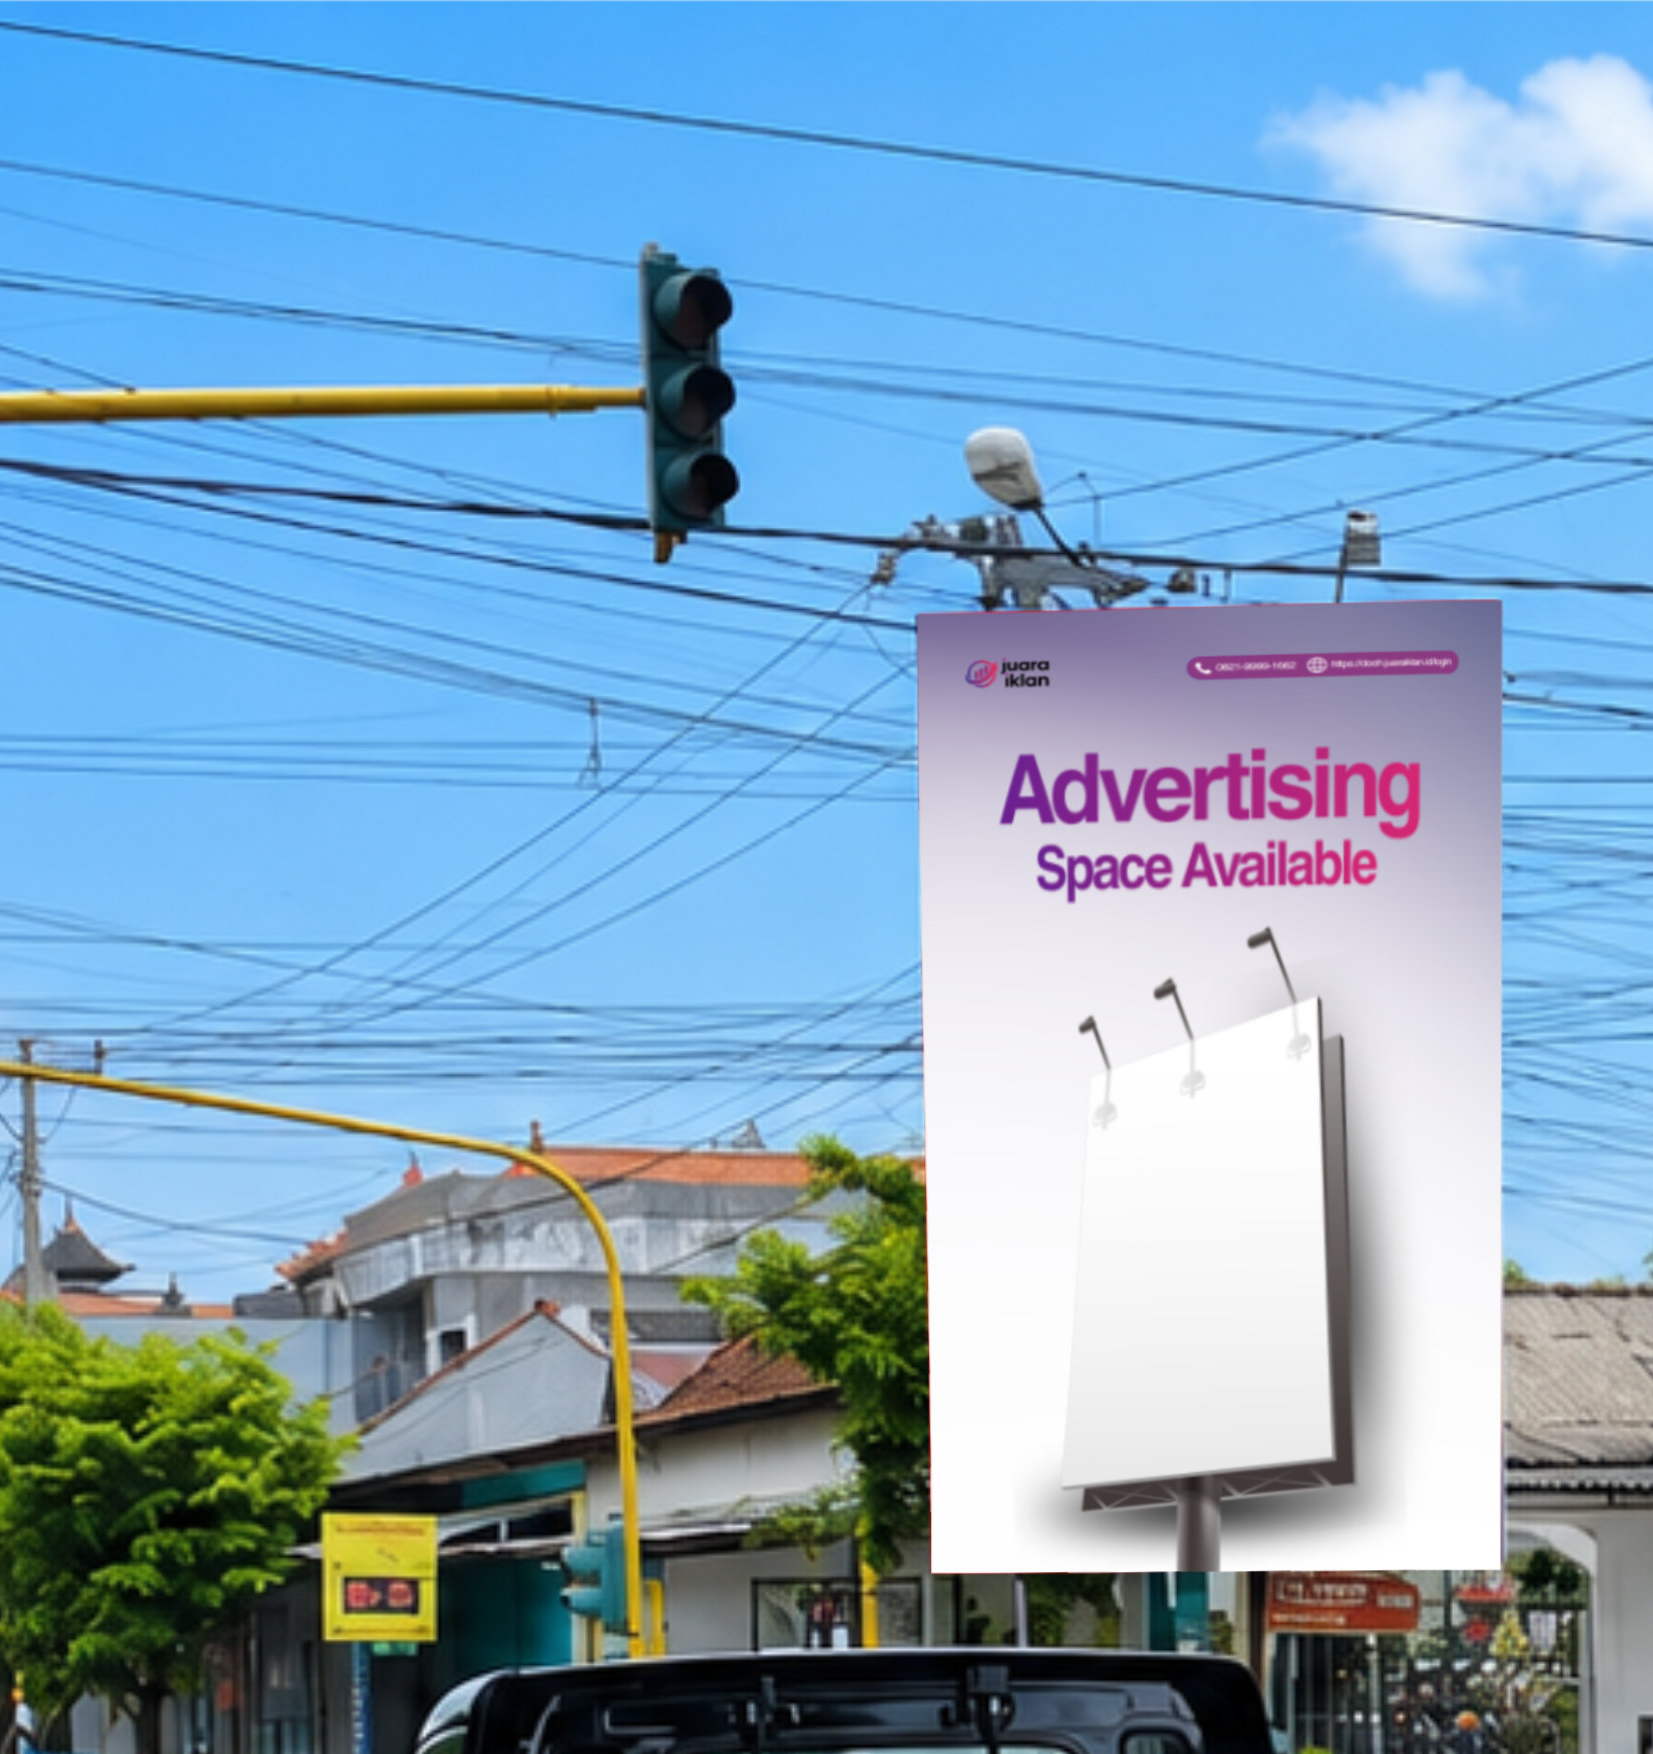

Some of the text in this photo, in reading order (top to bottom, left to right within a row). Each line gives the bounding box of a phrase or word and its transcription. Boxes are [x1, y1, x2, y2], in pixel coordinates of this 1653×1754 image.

[1000, 657, 1050, 674] juara
[1004, 672, 1050, 688] iklan
[999, 746, 1421, 840] Advertising
[1036, 839, 1378, 903] Space Available
